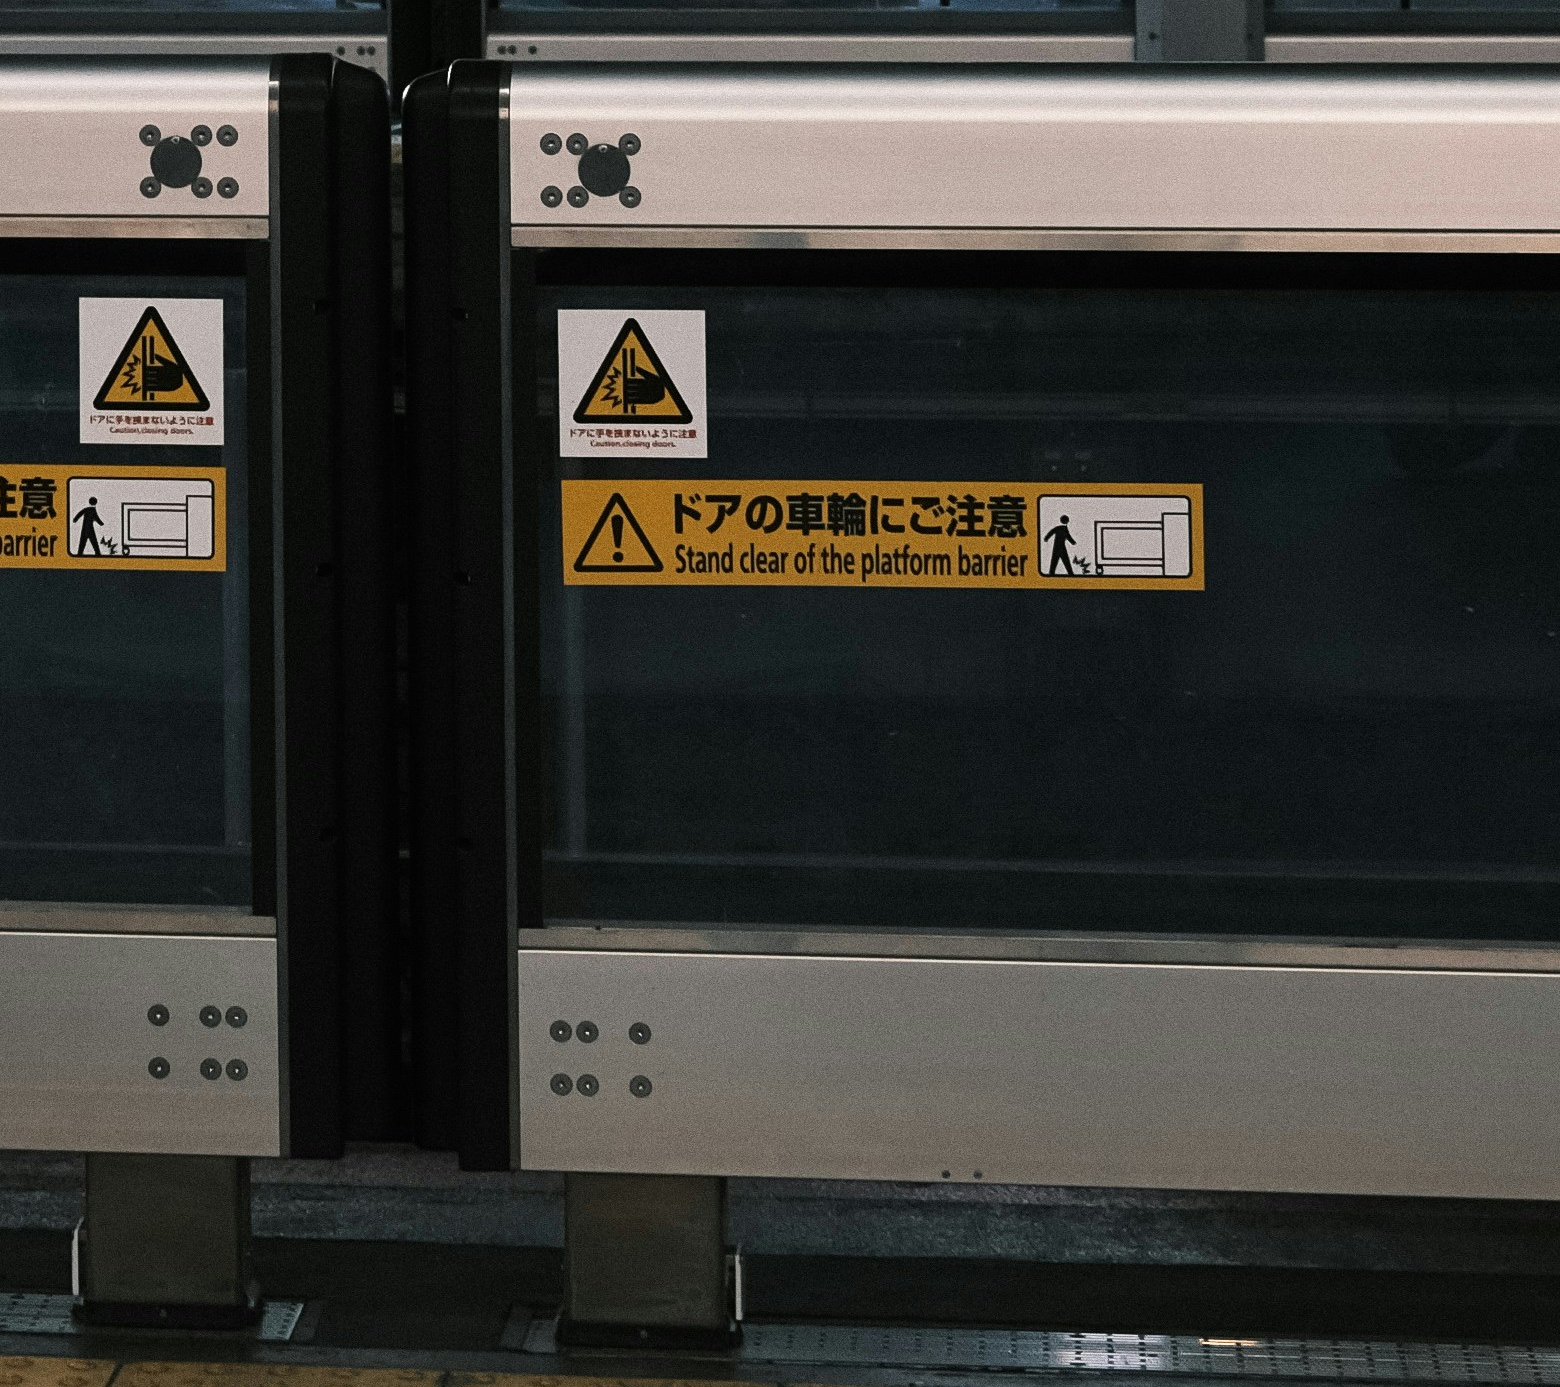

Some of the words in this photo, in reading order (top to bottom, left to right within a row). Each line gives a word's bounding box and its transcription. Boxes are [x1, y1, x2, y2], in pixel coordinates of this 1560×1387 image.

[674, 492, 1027, 538] ドアの車輪にご注意
[675, 543, 733, 574] Stand
[740, 543, 788, 575] clear
[794, 543, 816, 575] of
[821, 544, 855, 575] the
[861, 544, 951, 584] platform
[958, 544, 1028, 577] barrier
